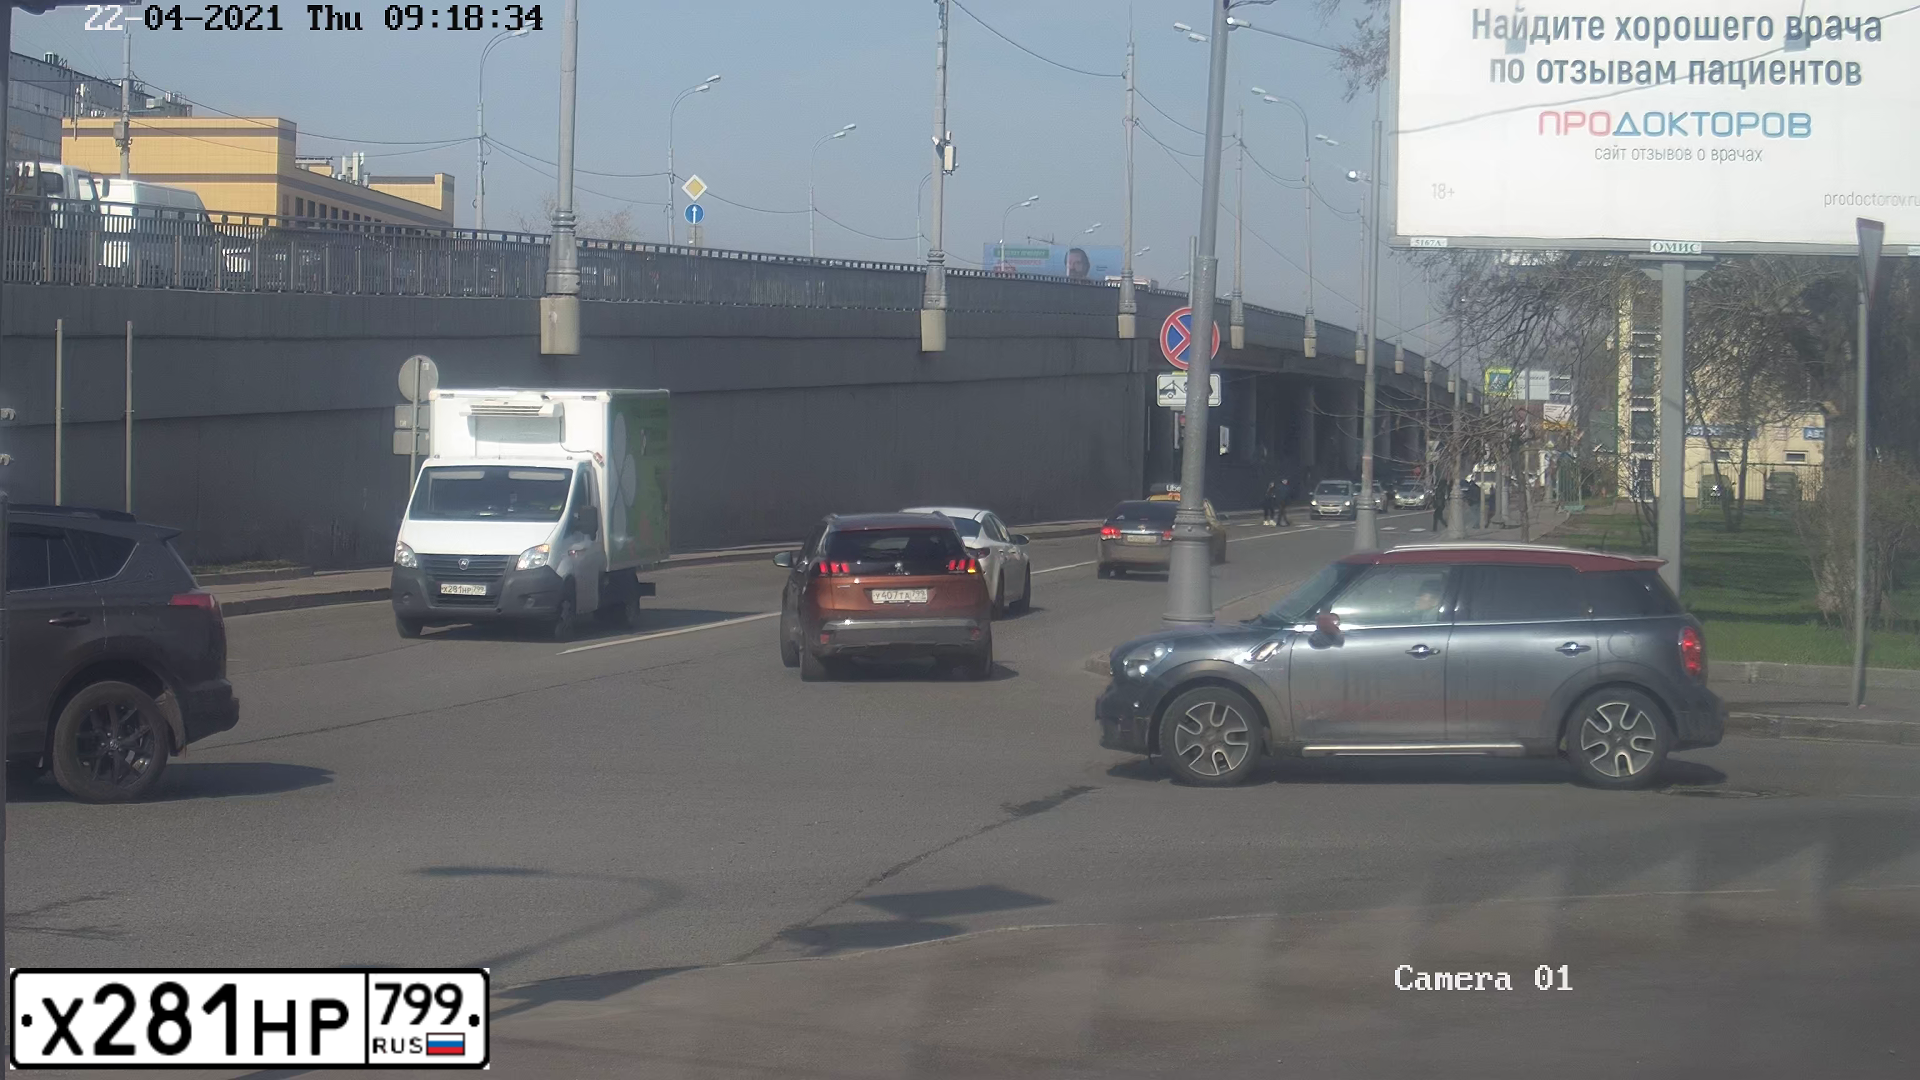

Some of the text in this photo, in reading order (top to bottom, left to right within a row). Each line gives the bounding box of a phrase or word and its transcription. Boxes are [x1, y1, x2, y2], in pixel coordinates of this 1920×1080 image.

[1472, 6, 1882, 49] Найдите хорошего врача
[1490, 58, 1863, 90] по отзывам пациентов
[1538, 111, 1813, 138] ПРОДОКТОРОВ
[1594, 145, 1763, 165] сайт отзывов о врачах
[1431, 183, 1455, 200] 18+
[1652, 241, 1701, 253] ОМИС
